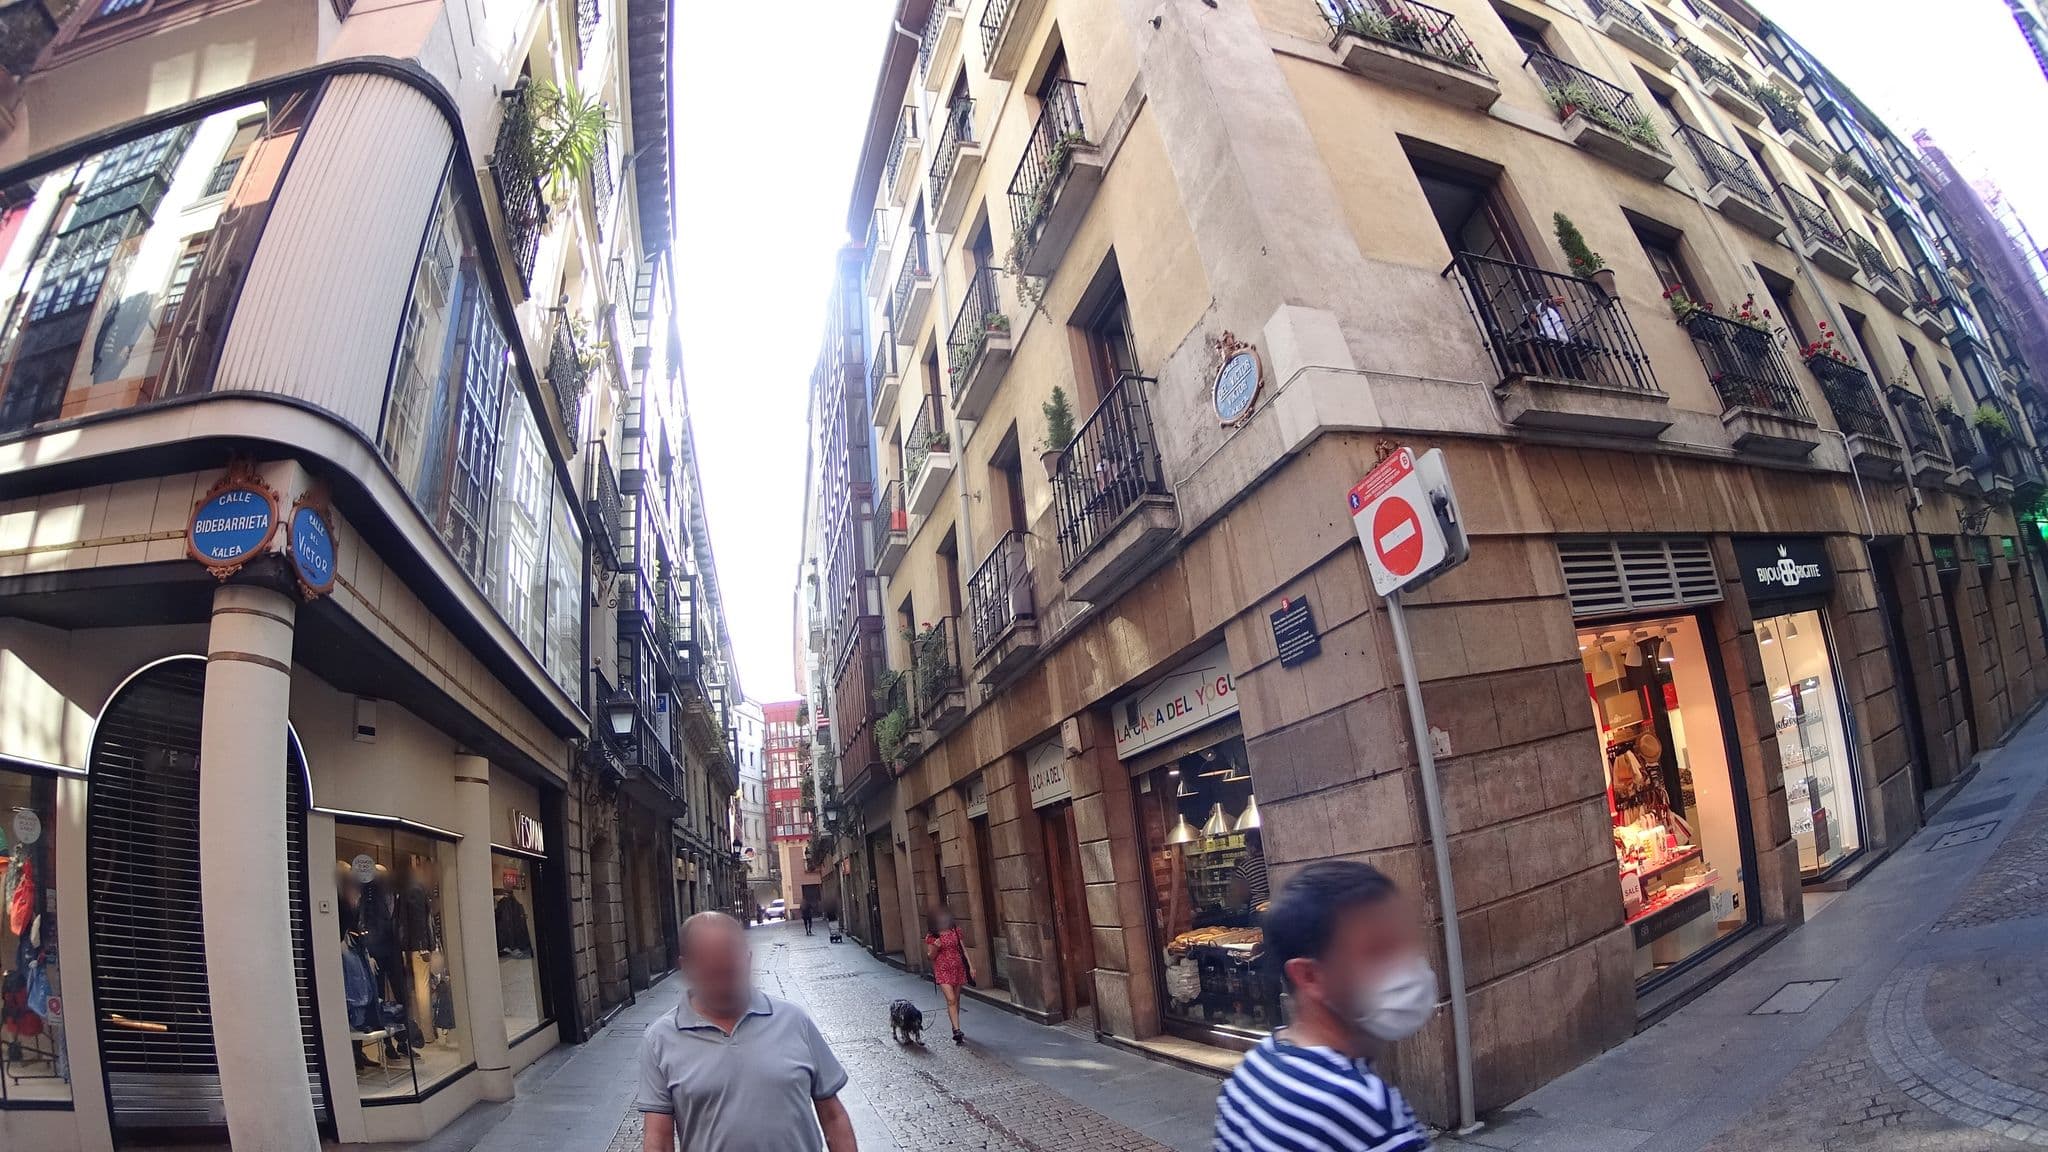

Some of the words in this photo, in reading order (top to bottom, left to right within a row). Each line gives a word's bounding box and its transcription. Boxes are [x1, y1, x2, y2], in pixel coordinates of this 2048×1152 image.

[219, 492, 252, 506] CALLE
[195, 514, 269, 534] BIDEBARRIETA
[309, 514, 326, 537] CALLE
[211, 545, 242, 558] KALEA
[298, 531, 328, 573] VICTOR
[1756, 566, 1781, 586] BIJOU
[1116, 724, 1132, 744] LA
[1166, 695, 1193, 720] DEL
[1624, 885, 1639, 896] SALE
